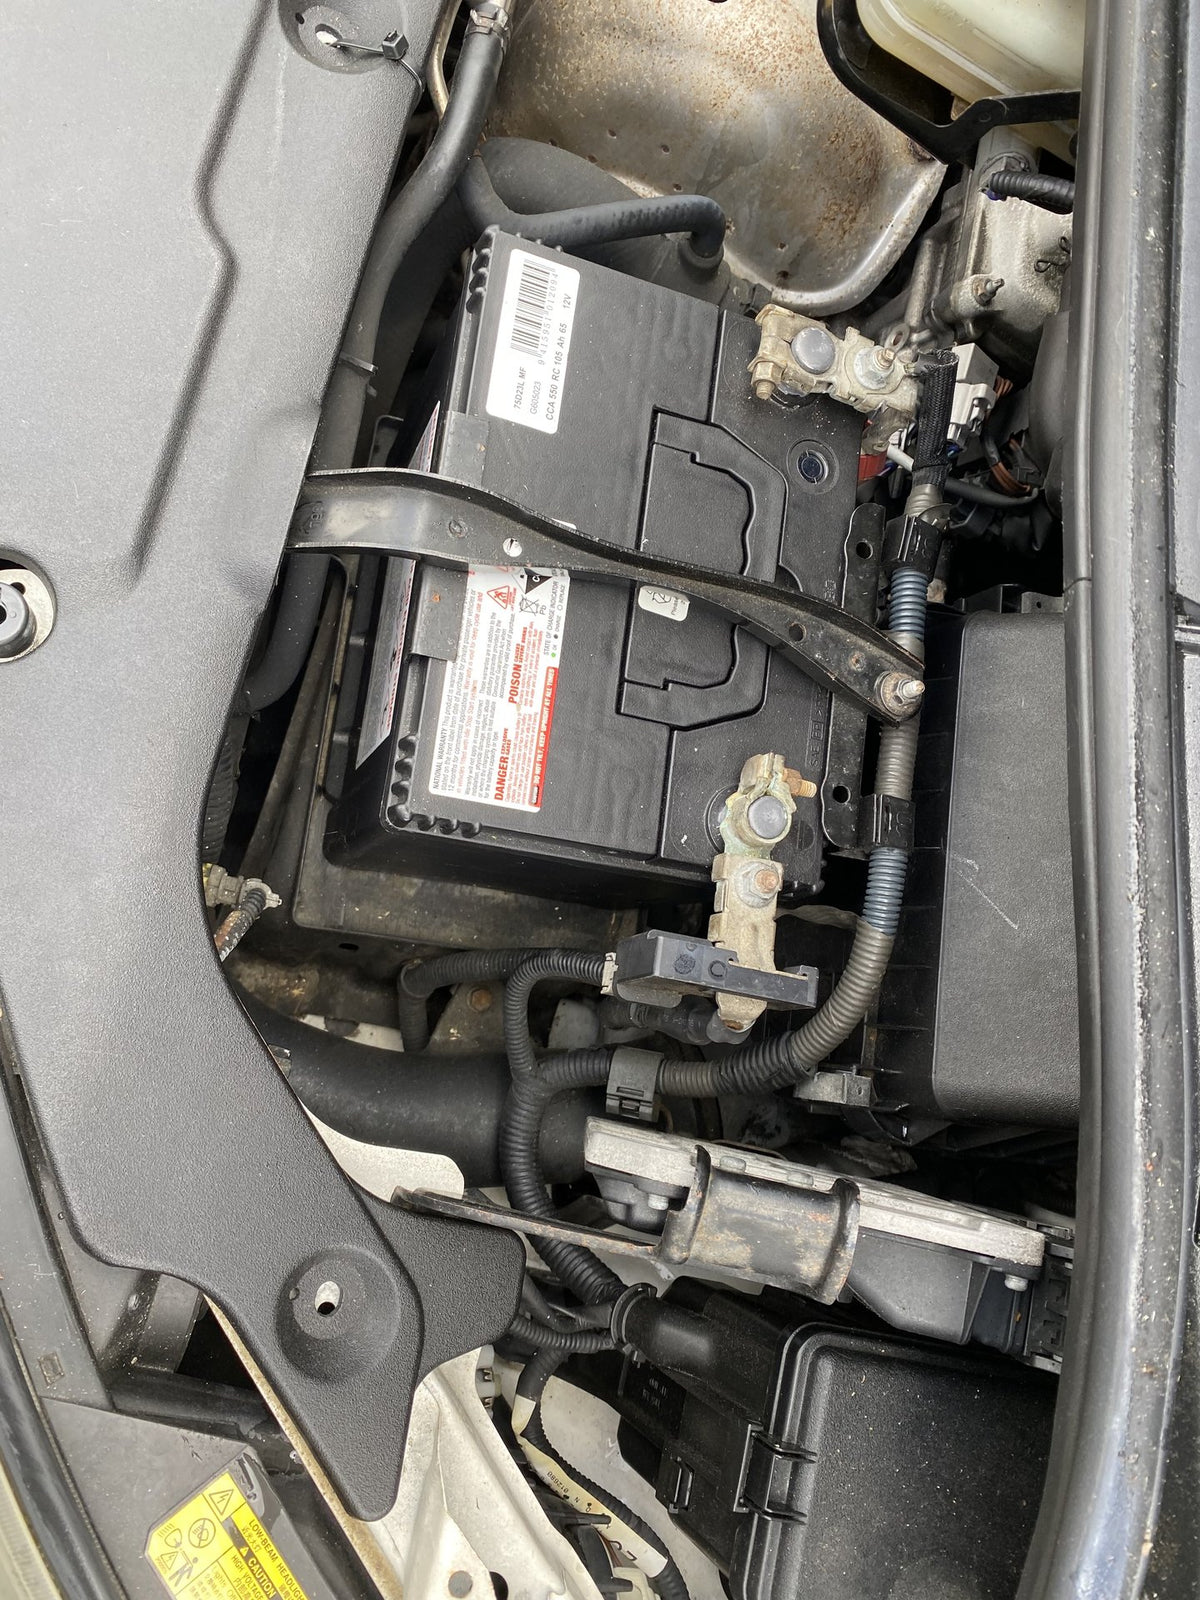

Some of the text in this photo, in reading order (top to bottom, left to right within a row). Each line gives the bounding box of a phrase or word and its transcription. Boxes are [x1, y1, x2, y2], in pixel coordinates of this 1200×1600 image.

[539, 315, 552, 355] 415951
[546, 271, 559, 311] 012094
[545, 293, 572, 420] CCA 550 RC 105 Ah 65 12V
[513, 365, 527, 410] 75D23L MF
[529, 380, 541, 415] G605023
[549, 580, 558, 608] INDICATOR
[539, 604, 546, 615] Pb
[546, 609, 554, 630] CHARGE
[543, 639, 551, 655] STATE
[507, 663, 522, 704] POISON
[546, 667, 554, 685] TIMES
[543, 697, 550, 706] AT
[544, 686, 552, 697] ALL
[540, 706, 549, 731] UPRIGHT
[436, 727, 447, 759] WARRANTY
[500, 727, 508, 754] EXPLOSIVE
[538, 731, 546, 747] KEEP
[432, 760, 442, 789] NATIONAL
[494, 755, 508, 800] DANGER
[533, 775, 540, 784] DO
[534, 762, 542, 774] NOT
[247, 1518, 279, 1562] LOW-BEAM
[229, 1554, 245, 1572] HIGH
[245, 1556, 277, 1598] CAUTION
